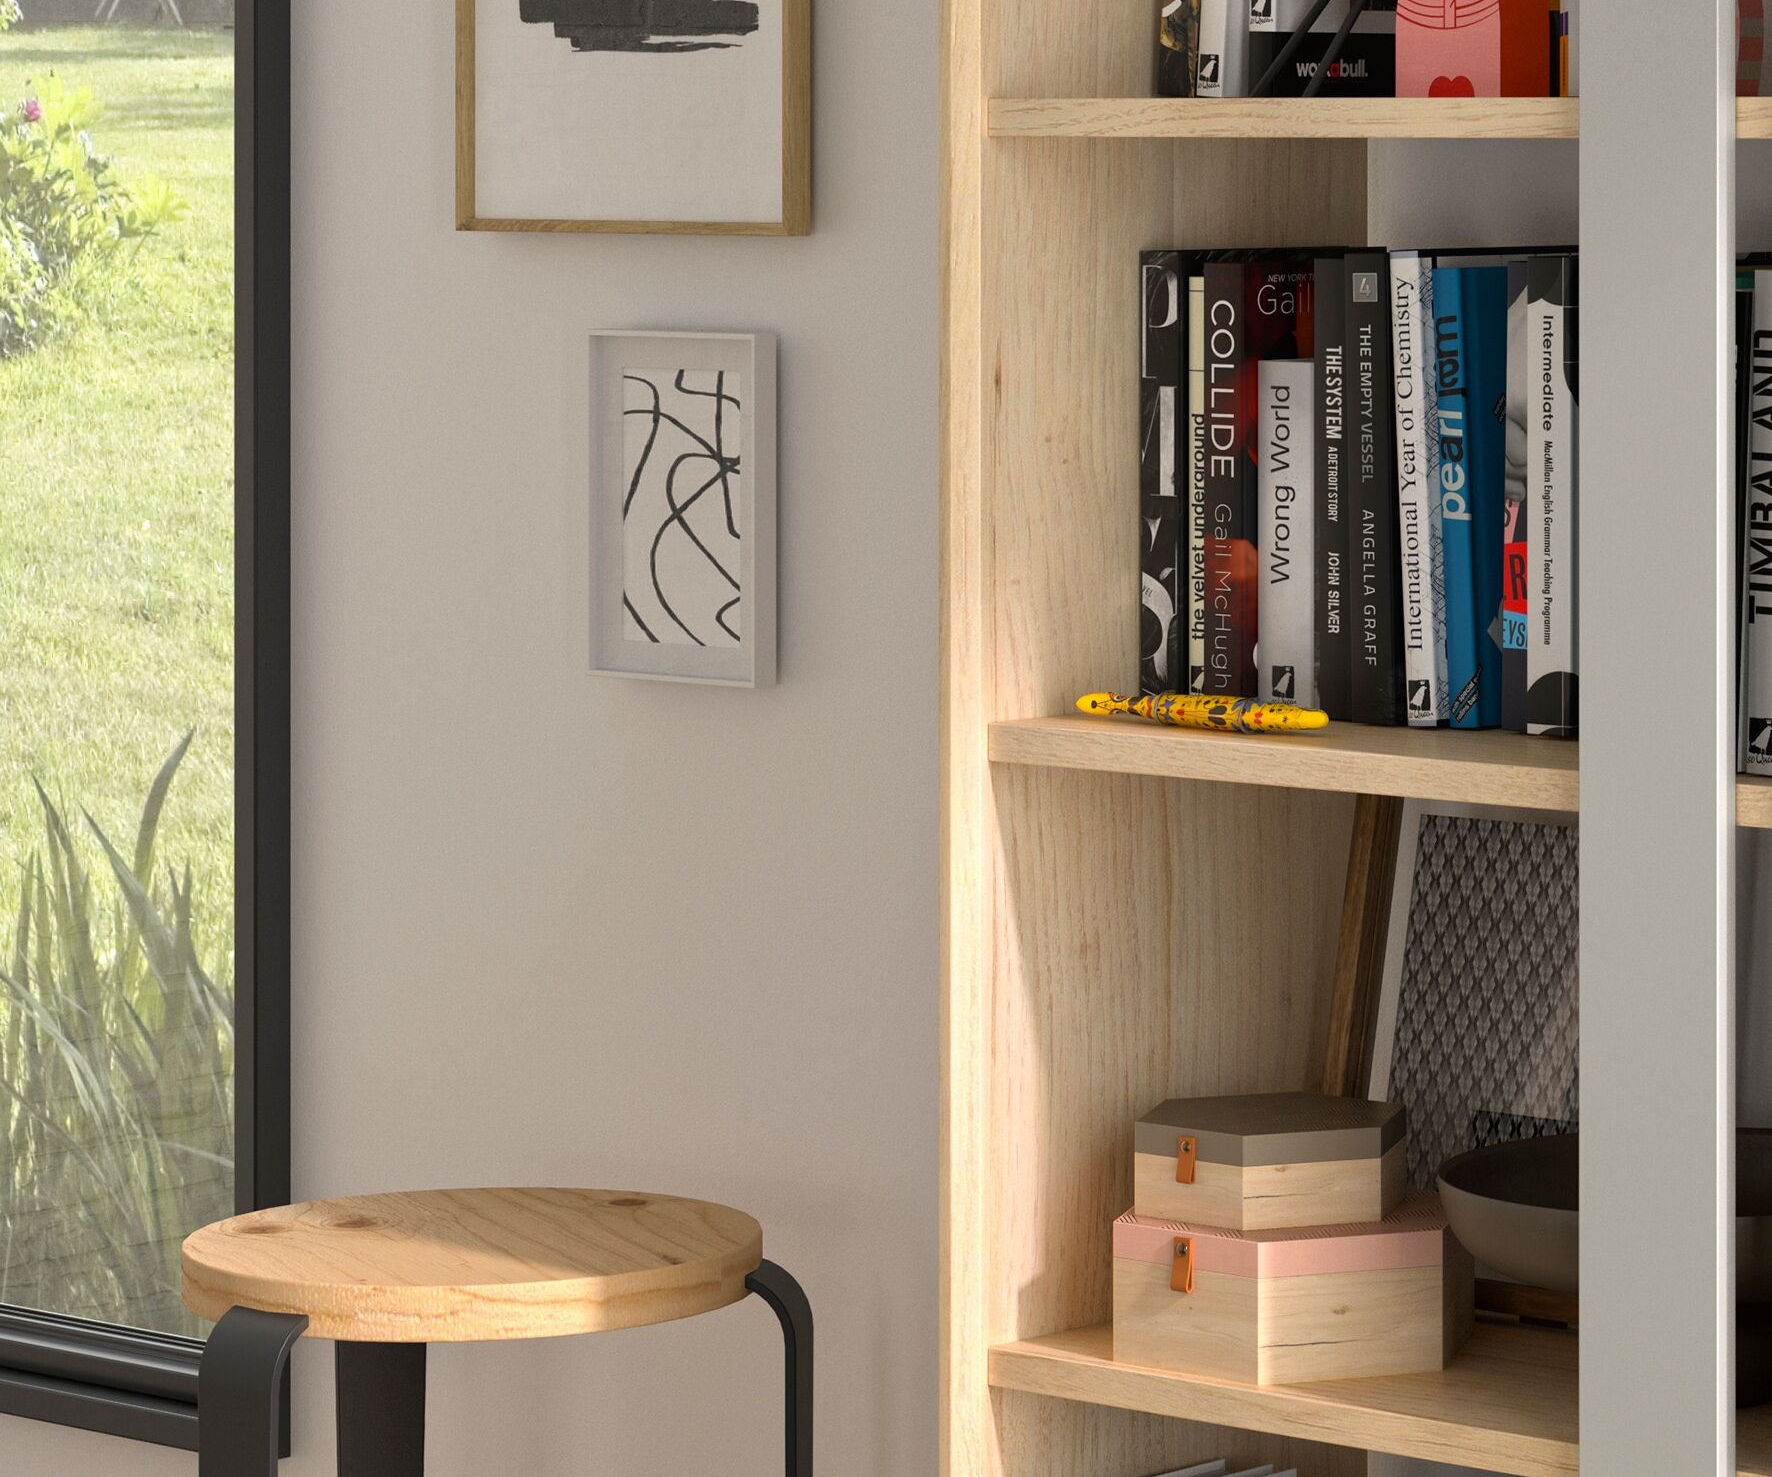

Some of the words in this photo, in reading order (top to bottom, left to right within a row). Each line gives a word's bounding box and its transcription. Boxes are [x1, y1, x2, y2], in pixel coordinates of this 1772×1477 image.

[1258, 282, 1310, 314] Gail
[1268, 274, 1286, 282] NEW
[1288, 273, 1306, 282] YORK
[1360, 324, 1372, 357] THE
[1394, 277, 1414, 399] Chemistry
[1435, 315, 1467, 398] jam
[1210, 300, 1235, 478] COLLIDE
[1360, 362, 1373, 418] EMPTY
[1543, 316, 1554, 432] Intermediate
[1270, 385, 1290, 473] World
[1397, 403, 1414, 432] of
[1192, 414, 1204, 540] underground
[1361, 423, 1374, 484] VESSEL
[1400, 439, 1417, 492] Year
[1438, 410, 1472, 521] pearl
[1544, 440, 1554, 483] MacMillan
[1542, 485, 1554, 515] English
[1214, 503, 1232, 557] Gail
[1270, 485, 1296, 584] Wrong
[1362, 509, 1376, 596] ANGELLA
[1544, 517, 1553, 556] Grammar
[1192, 546, 1204, 602] velvet
[1328, 551, 1340, 586] JOHN
[1402, 502, 1422, 650] International
[1542, 559, 1554, 595] Teaching
[1192, 609, 1204, 640] the
[1211, 570, 1232, 688] McHugh
[1328, 590, 1340, 634] SILVER
[1364, 604, 1377, 668] GRAFF
[1542, 597, 1553, 646] Programme
